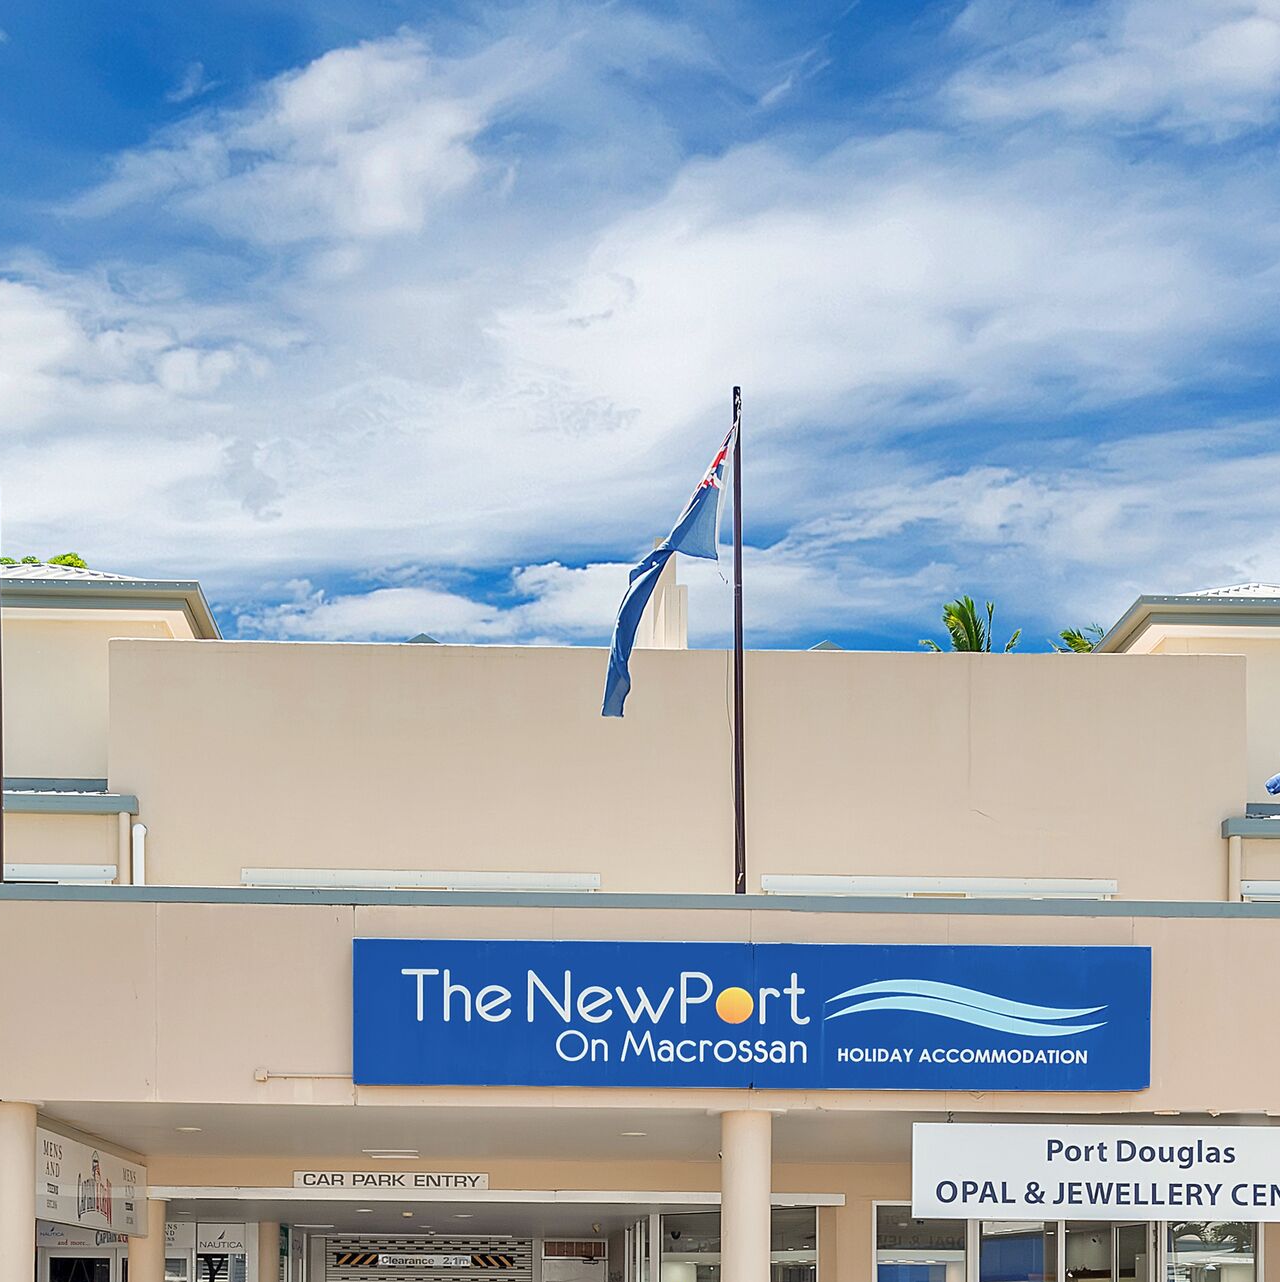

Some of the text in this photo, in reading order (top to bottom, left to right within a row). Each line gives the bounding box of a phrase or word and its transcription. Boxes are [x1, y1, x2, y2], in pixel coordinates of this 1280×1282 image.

[401, 968, 810, 1025] The NewPort
[556, 1030, 808, 1063] On Macrossan
[837, 1048, 1088, 1064] HOLIDAY ACCOMMODATION
[43, 1139, 63, 1160] MENS
[1045, 1139, 1236, 1169] Port Douglas
[45, 1161, 61, 1178] AND
[303, 1173, 481, 1188] CAR PARK ENTRY
[935, 1180, 1016, 1204] OPAL
[1024, 1181, 1045, 1204] &
[1052, 1182, 1223, 1206] JEWELLERY
[199, 1241, 244, 1249] NAUTICA
[380, 1255, 469, 1266] Clearance 2.1m
